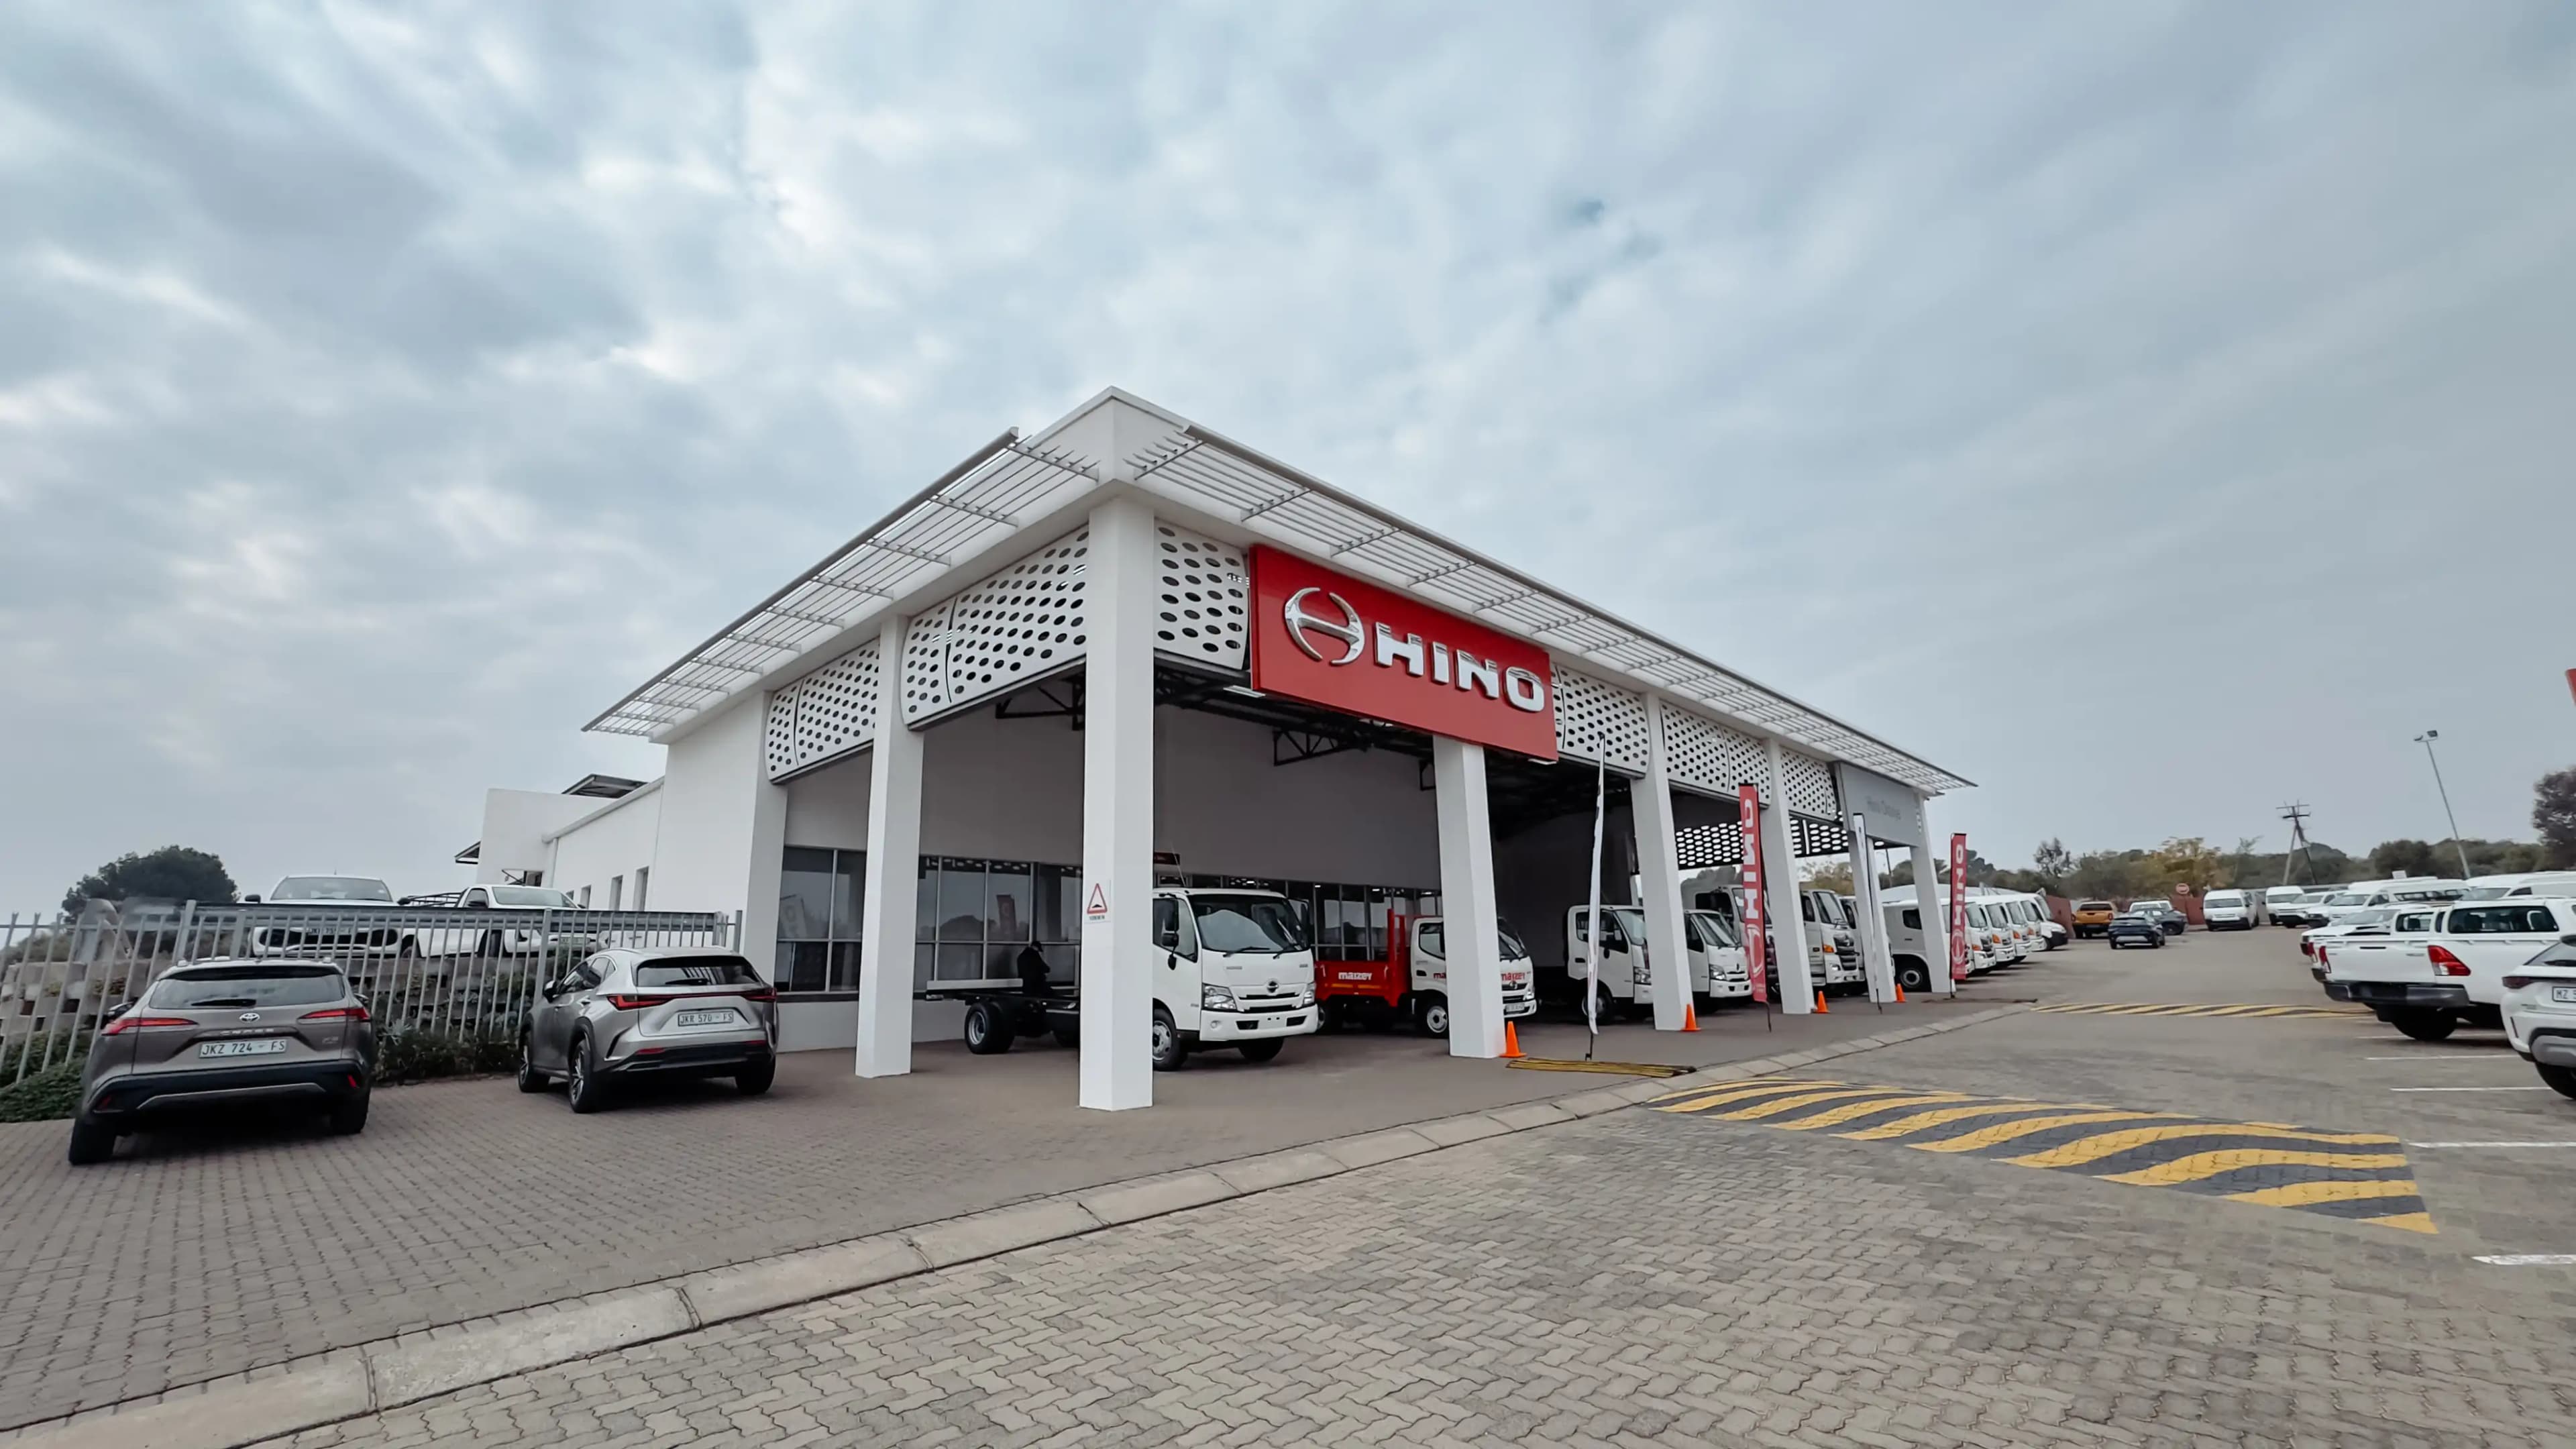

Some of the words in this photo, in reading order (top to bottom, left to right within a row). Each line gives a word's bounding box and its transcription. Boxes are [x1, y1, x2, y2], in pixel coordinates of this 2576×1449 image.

[1376, 621, 1544, 712] HINO
[1744, 799, 1759, 919] HINO
[1955, 844, 1964, 925] HINO
[202, 1044, 225, 1055] JKZ
[231, 1042, 252, 1053] 724
[271, 1040, 285, 1051] FS
[680, 1014, 695, 1024] JKR
[698, 1014, 712, 1022] 570
